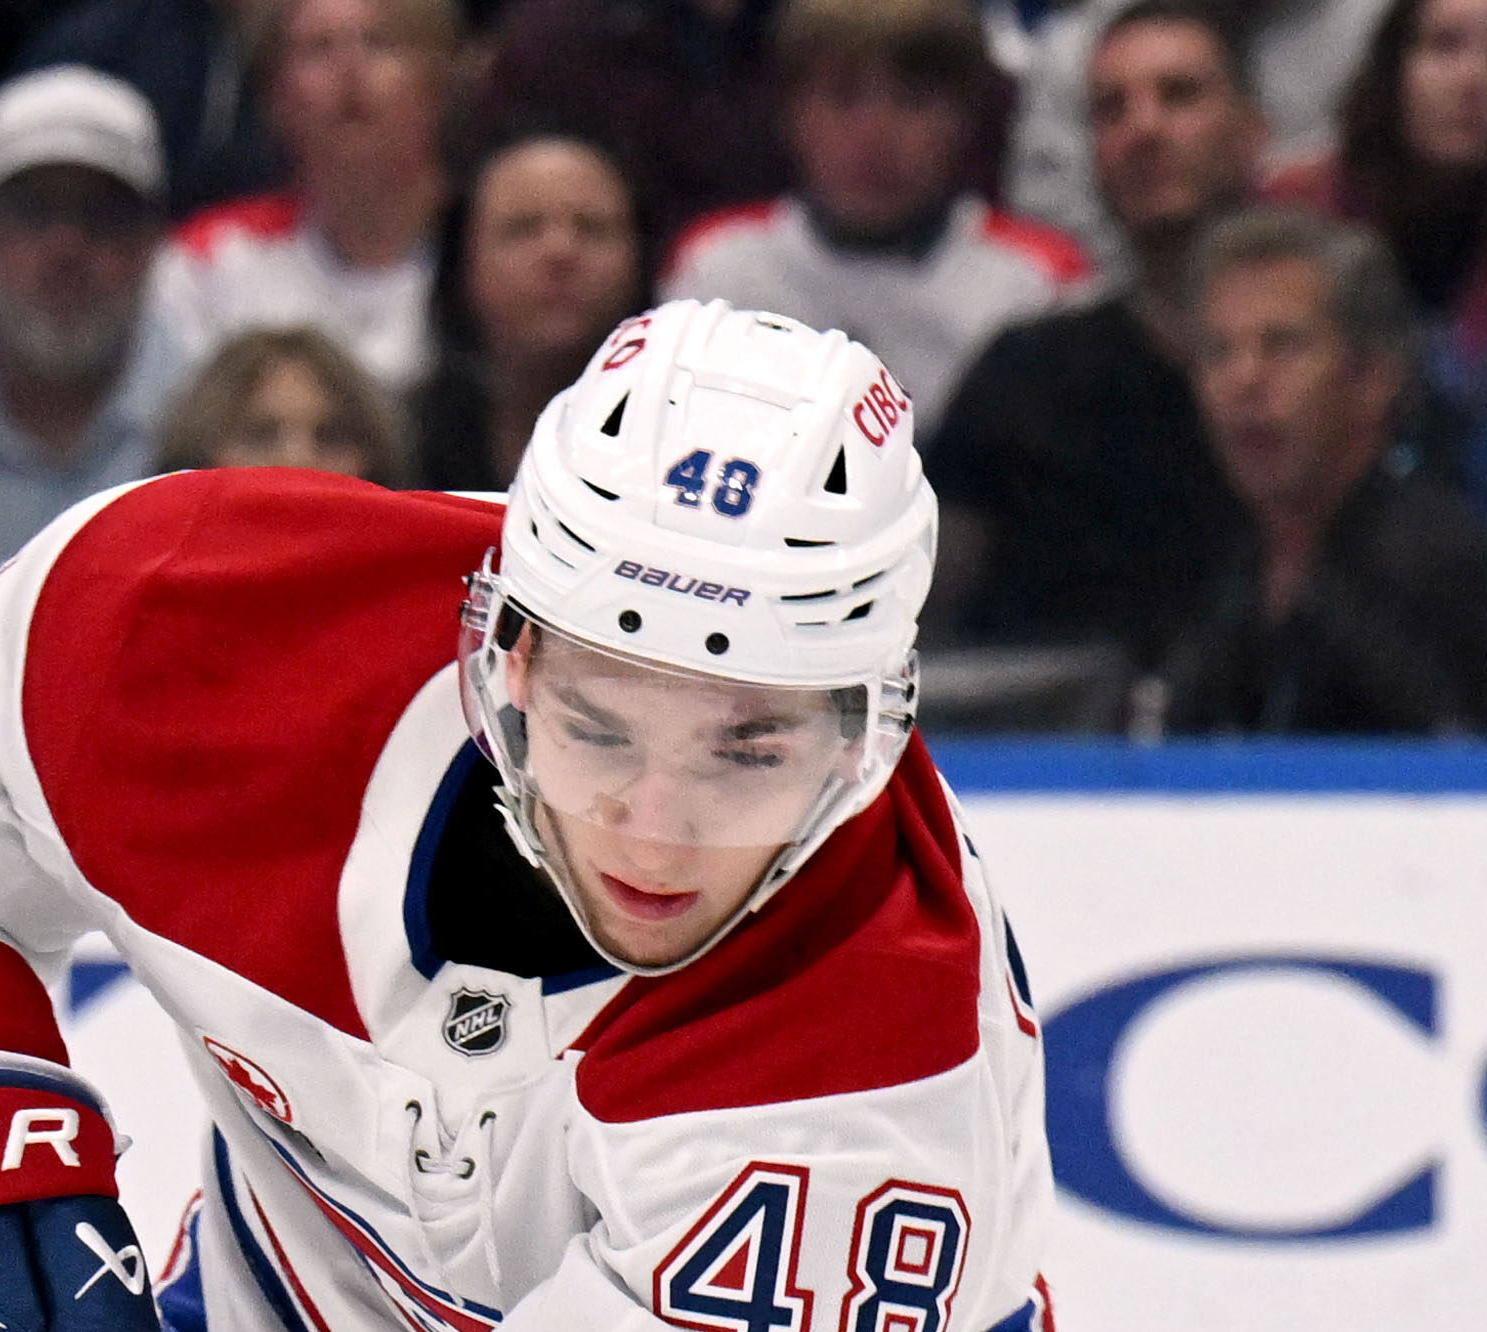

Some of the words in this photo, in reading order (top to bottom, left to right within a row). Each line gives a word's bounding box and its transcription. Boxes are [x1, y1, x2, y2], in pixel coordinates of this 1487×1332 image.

[852, 367, 909, 448] CIBC
[664, 447, 763, 518] 48
[613, 559, 753, 608] BAUER
[454, 1006, 498, 1040] NHL
